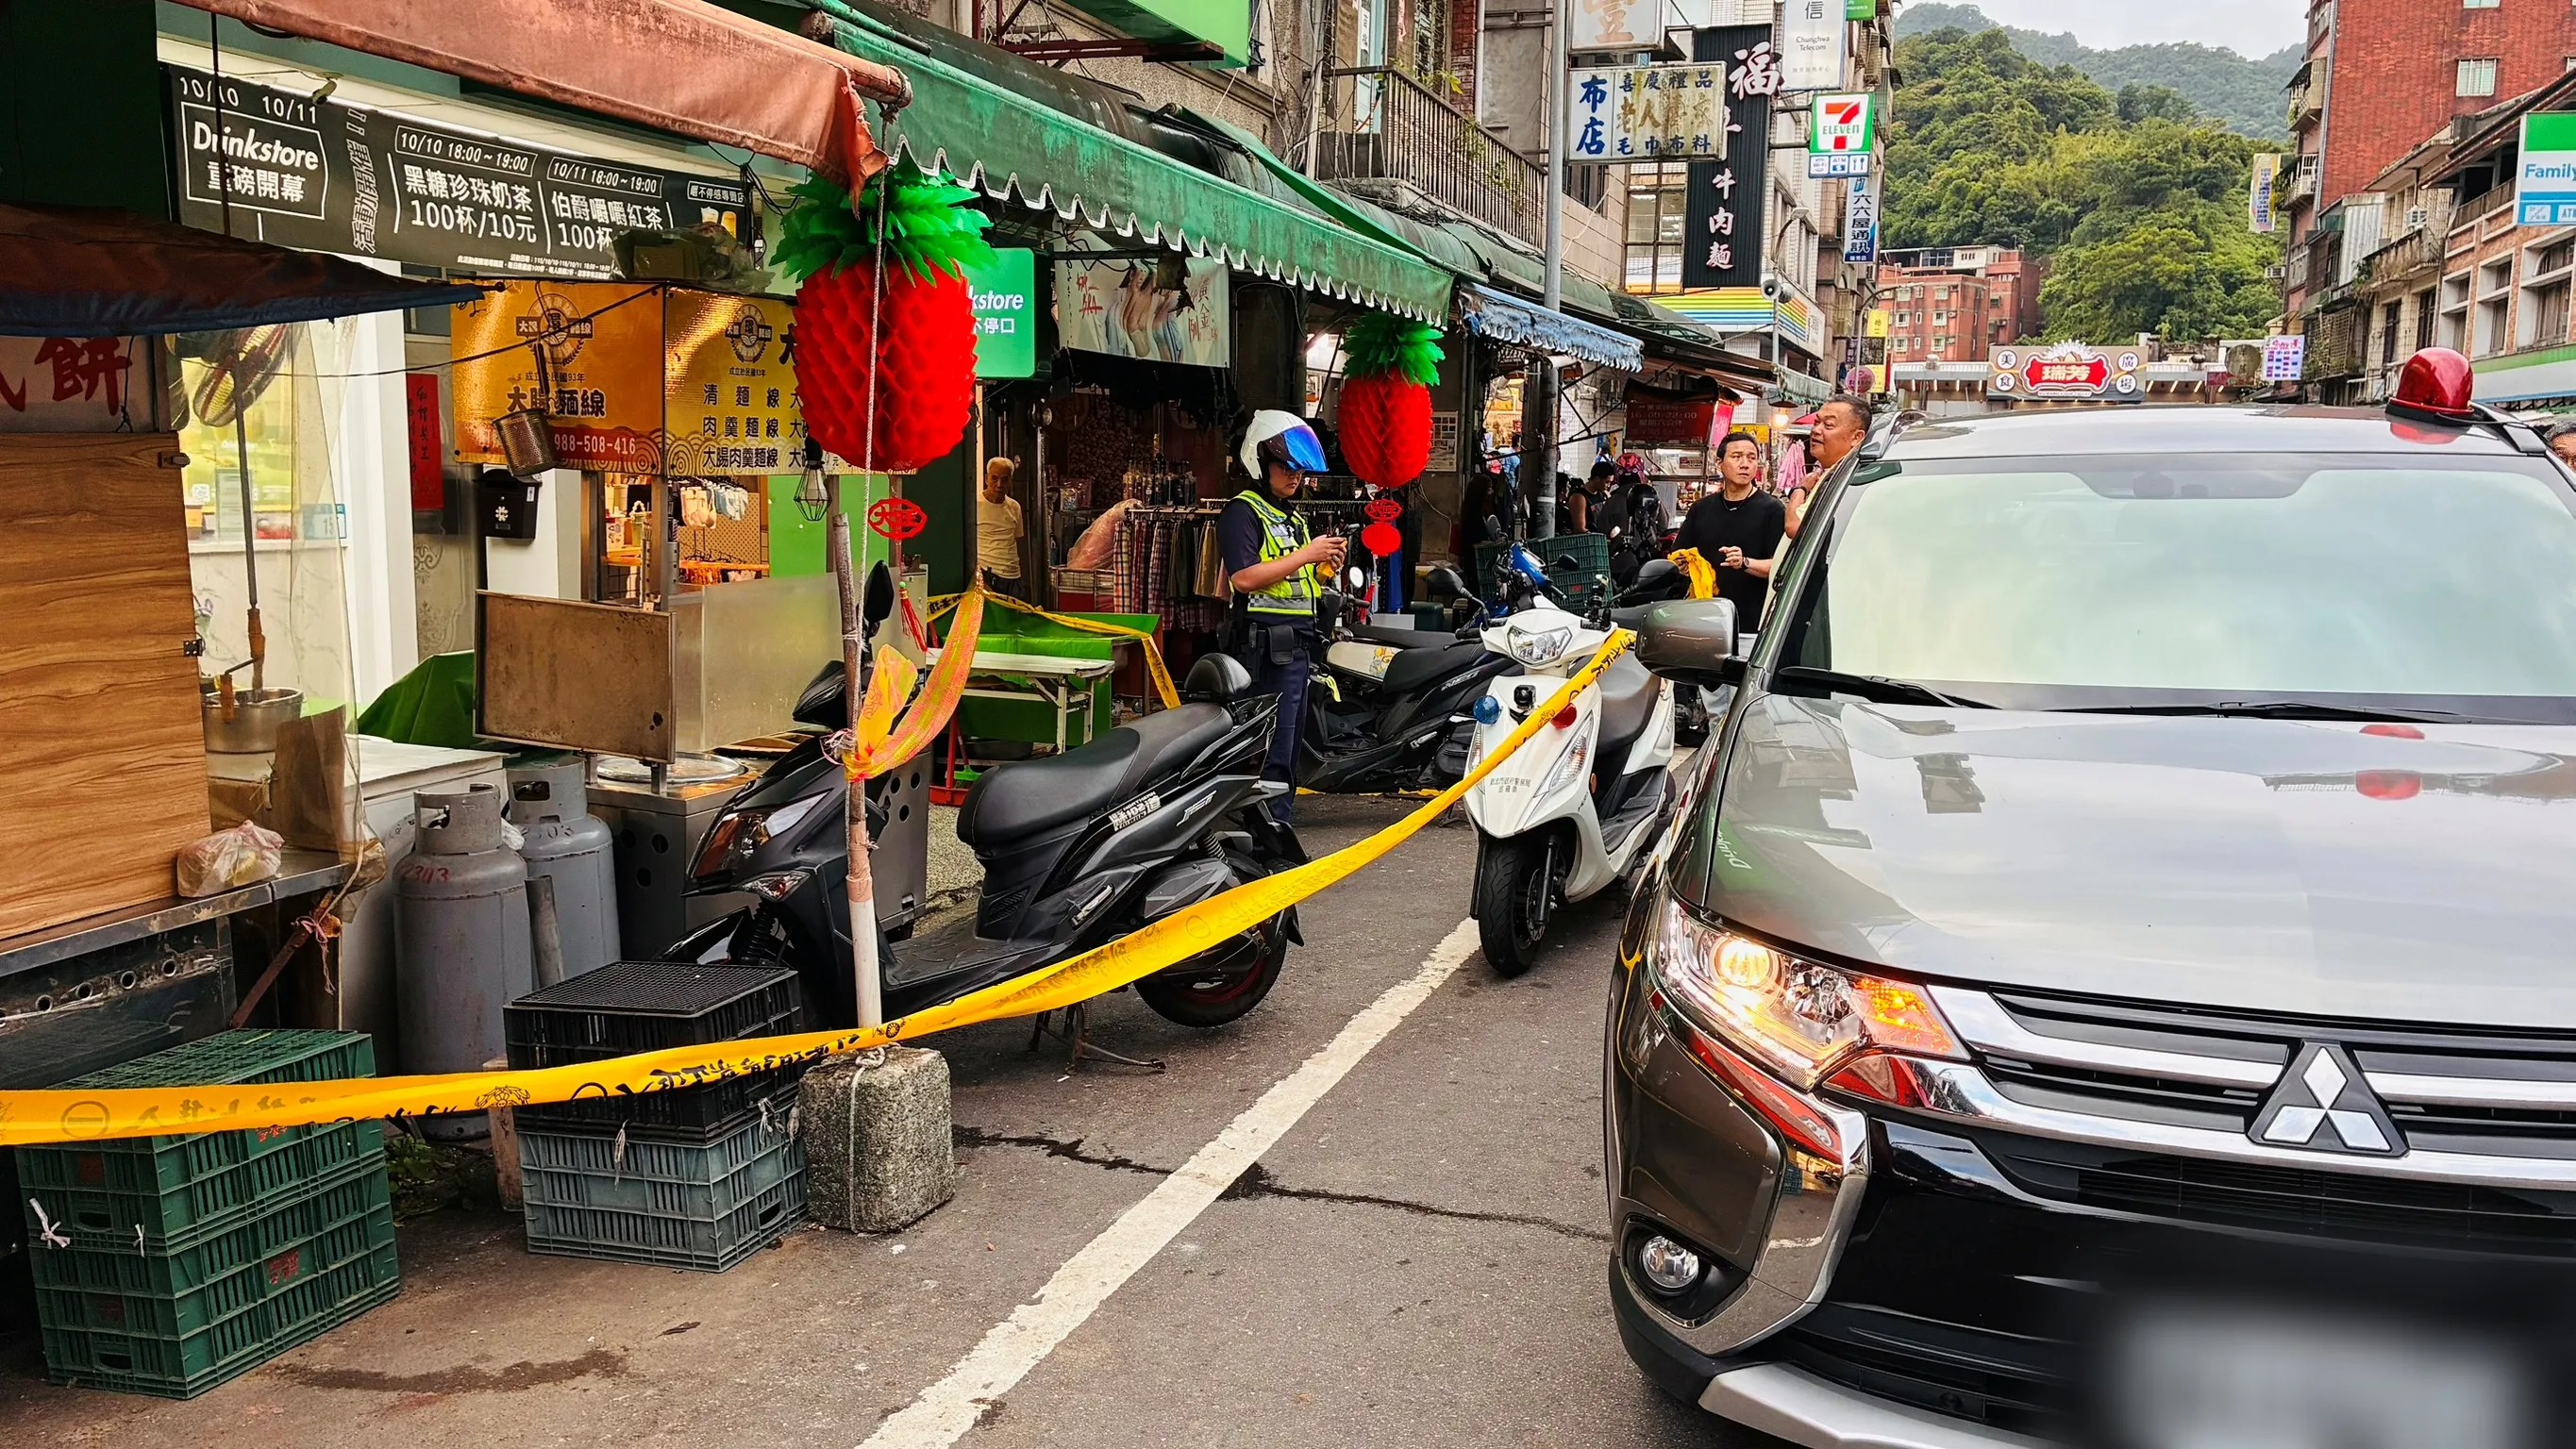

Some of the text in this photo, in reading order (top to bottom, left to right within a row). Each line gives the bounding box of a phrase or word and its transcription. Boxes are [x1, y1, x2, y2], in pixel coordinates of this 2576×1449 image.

[1805, 1, 1824, 20] 信
[1796, 36, 1830, 44] Chunghwa
[1619, 70, 1714, 92] 喜慶禮品
[180, 77, 318, 125] 10/10 10/11
[1577, 75, 1607, 155] 布店
[402, 132, 443, 154] 10/10
[1616, 133, 1712, 155] 毛巾布料
[208, 160, 306, 202] 重磅開幕
[553, 162, 586, 181] 10/11
[404, 164, 534, 213] 黑糖珍珠奶茶
[410, 199, 537, 243] 100杯/10元
[551, 191, 663, 231] 伯爵嚼嚼紅茶
[1850, 194, 1872, 253] 六六屋通訊
[0, 337, 133, 416] 餅
[2041, 364, 2091, 382] 瑞芳
[703, 415, 779, 439] 肉羹麵線
[703, 446, 779, 468] 大腸肉羹麵線
